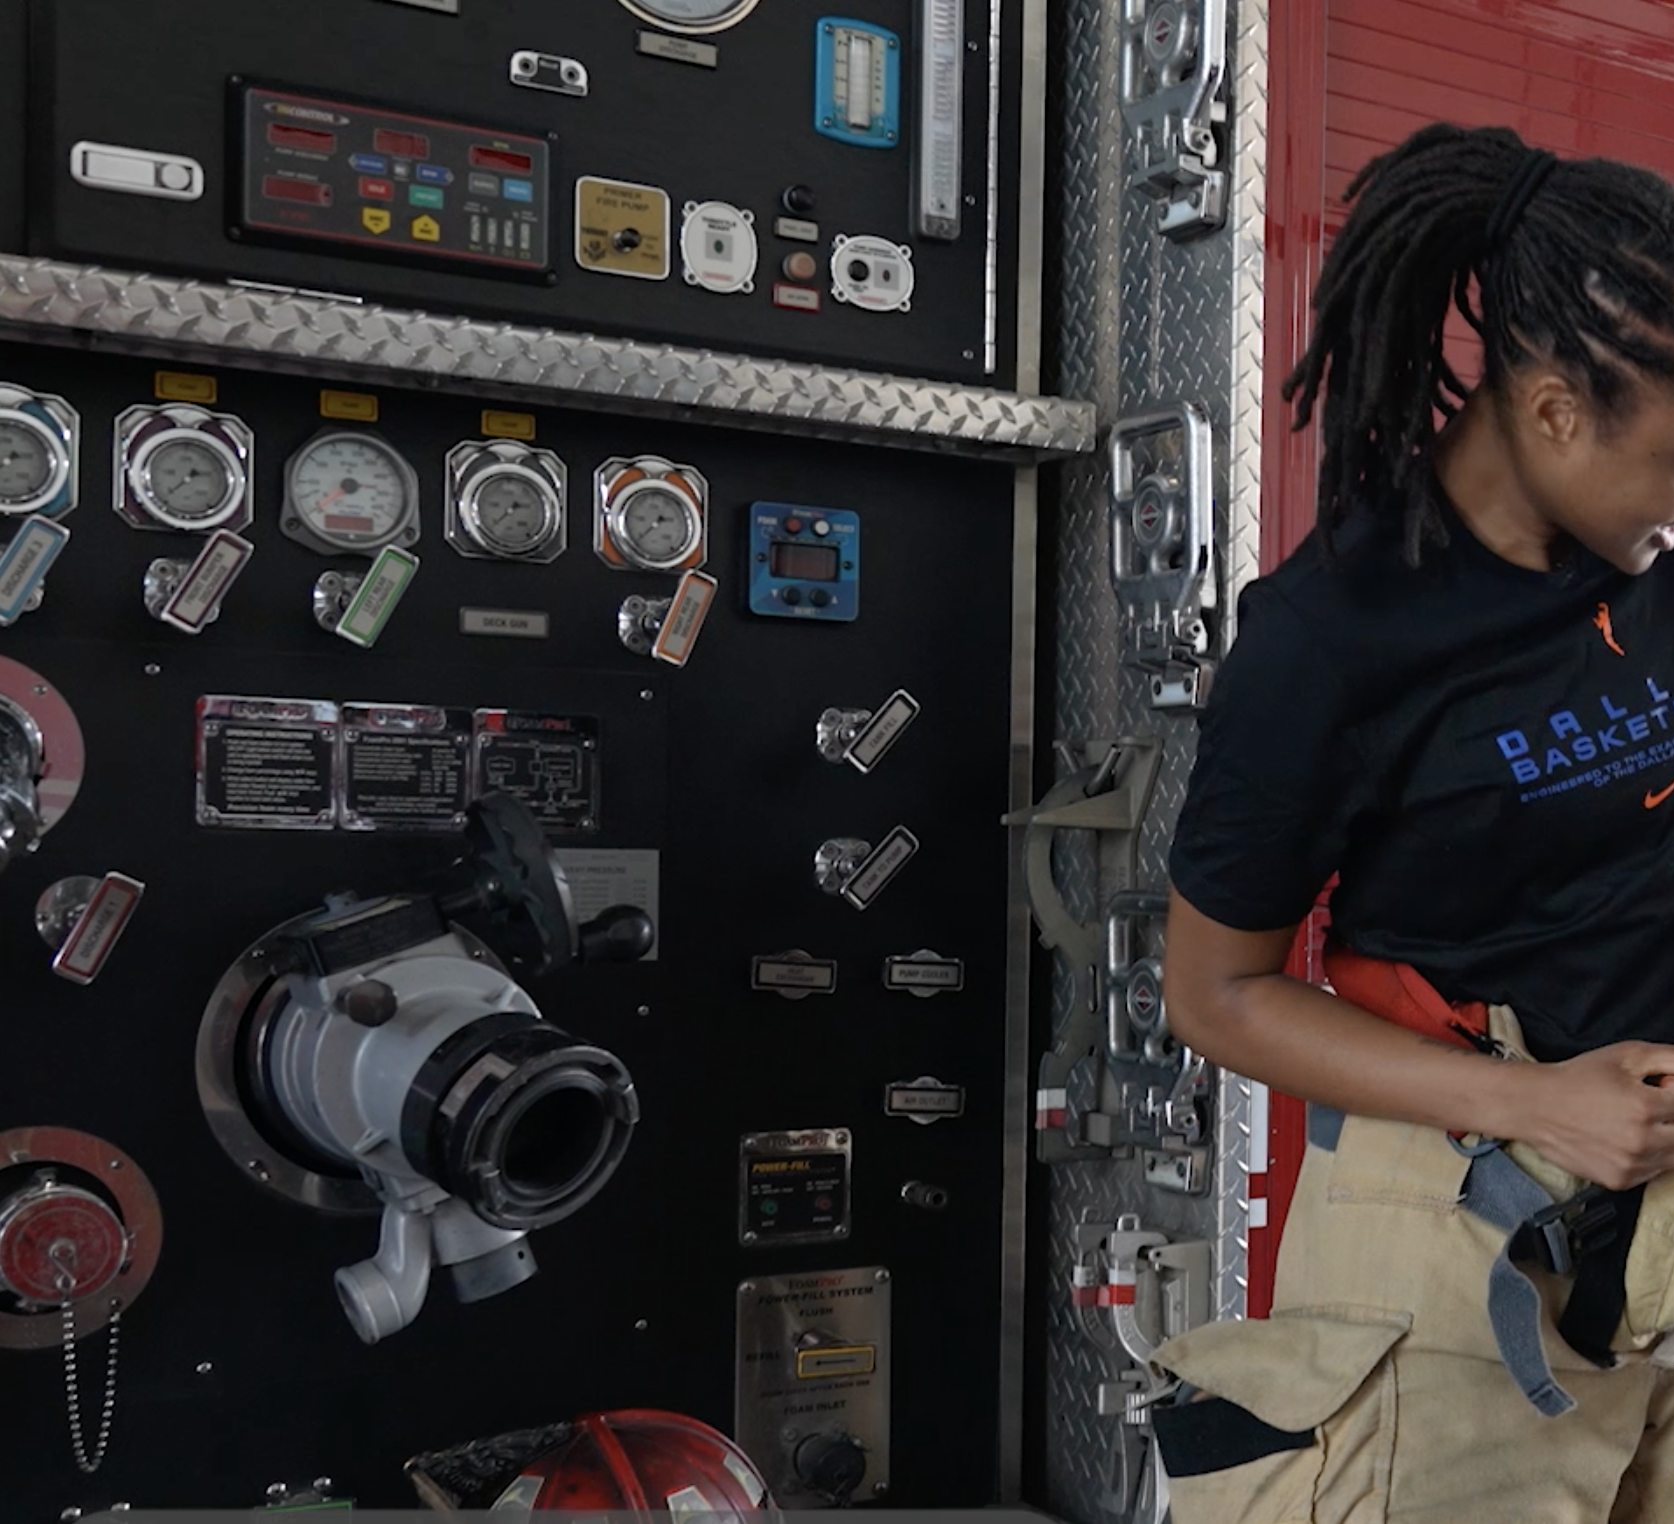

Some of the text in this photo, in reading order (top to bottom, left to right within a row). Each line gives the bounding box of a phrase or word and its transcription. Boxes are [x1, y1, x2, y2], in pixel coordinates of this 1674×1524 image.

[604, 187, 642, 199] PRIMER
[596, 197, 649, 212] FIRE PUMP
[483, 617, 529, 629] DECK GUN
[868, 717, 899, 749] TANK FILL
[1519, 768, 1602, 803] ENGINEERED
[1603, 760, 1622, 774] TO
[1623, 750, 1646, 767] THE
[1593, 774, 1611, 788] OF
[1614, 764, 1636, 780] THE
[861, 872, 879, 891] TANK
[899, 969, 950, 980] PUMP COOLER
[904, 1096, 946, 1106] AIR OUTLET
[829, 1286, 874, 1298] SYSTEM
[799, 1307, 834, 1317] FLUSH
[784, 1401, 846, 1416] FOAM INLET
